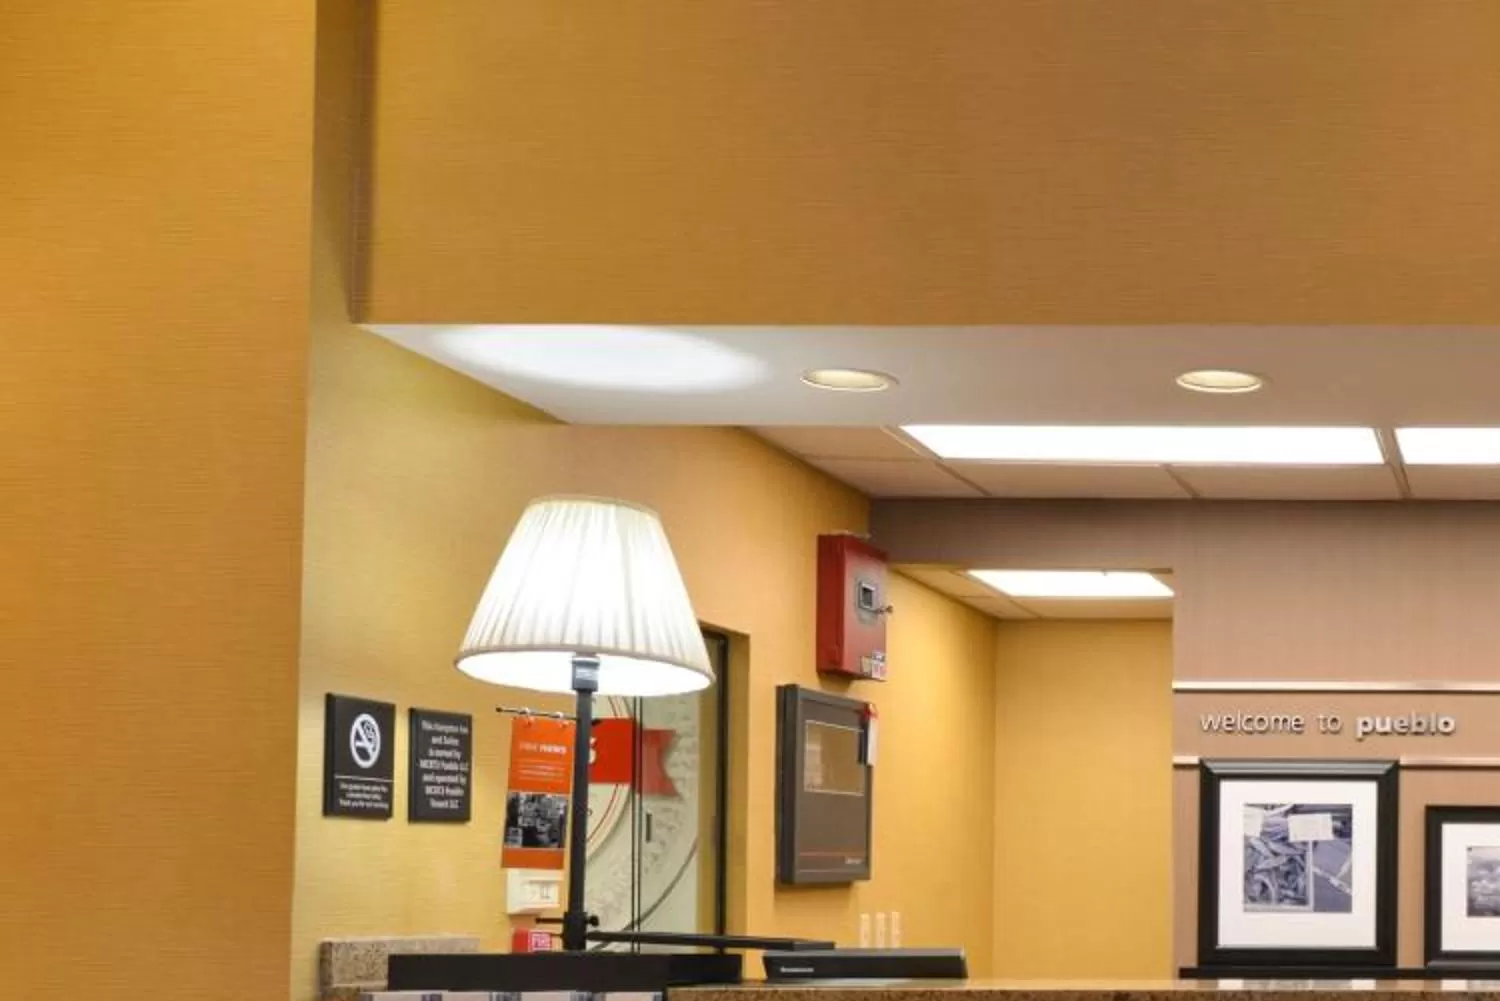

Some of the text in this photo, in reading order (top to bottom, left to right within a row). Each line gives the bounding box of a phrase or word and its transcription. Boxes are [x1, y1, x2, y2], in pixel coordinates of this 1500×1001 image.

[1200, 711, 1457, 742] welcome to pueblo
